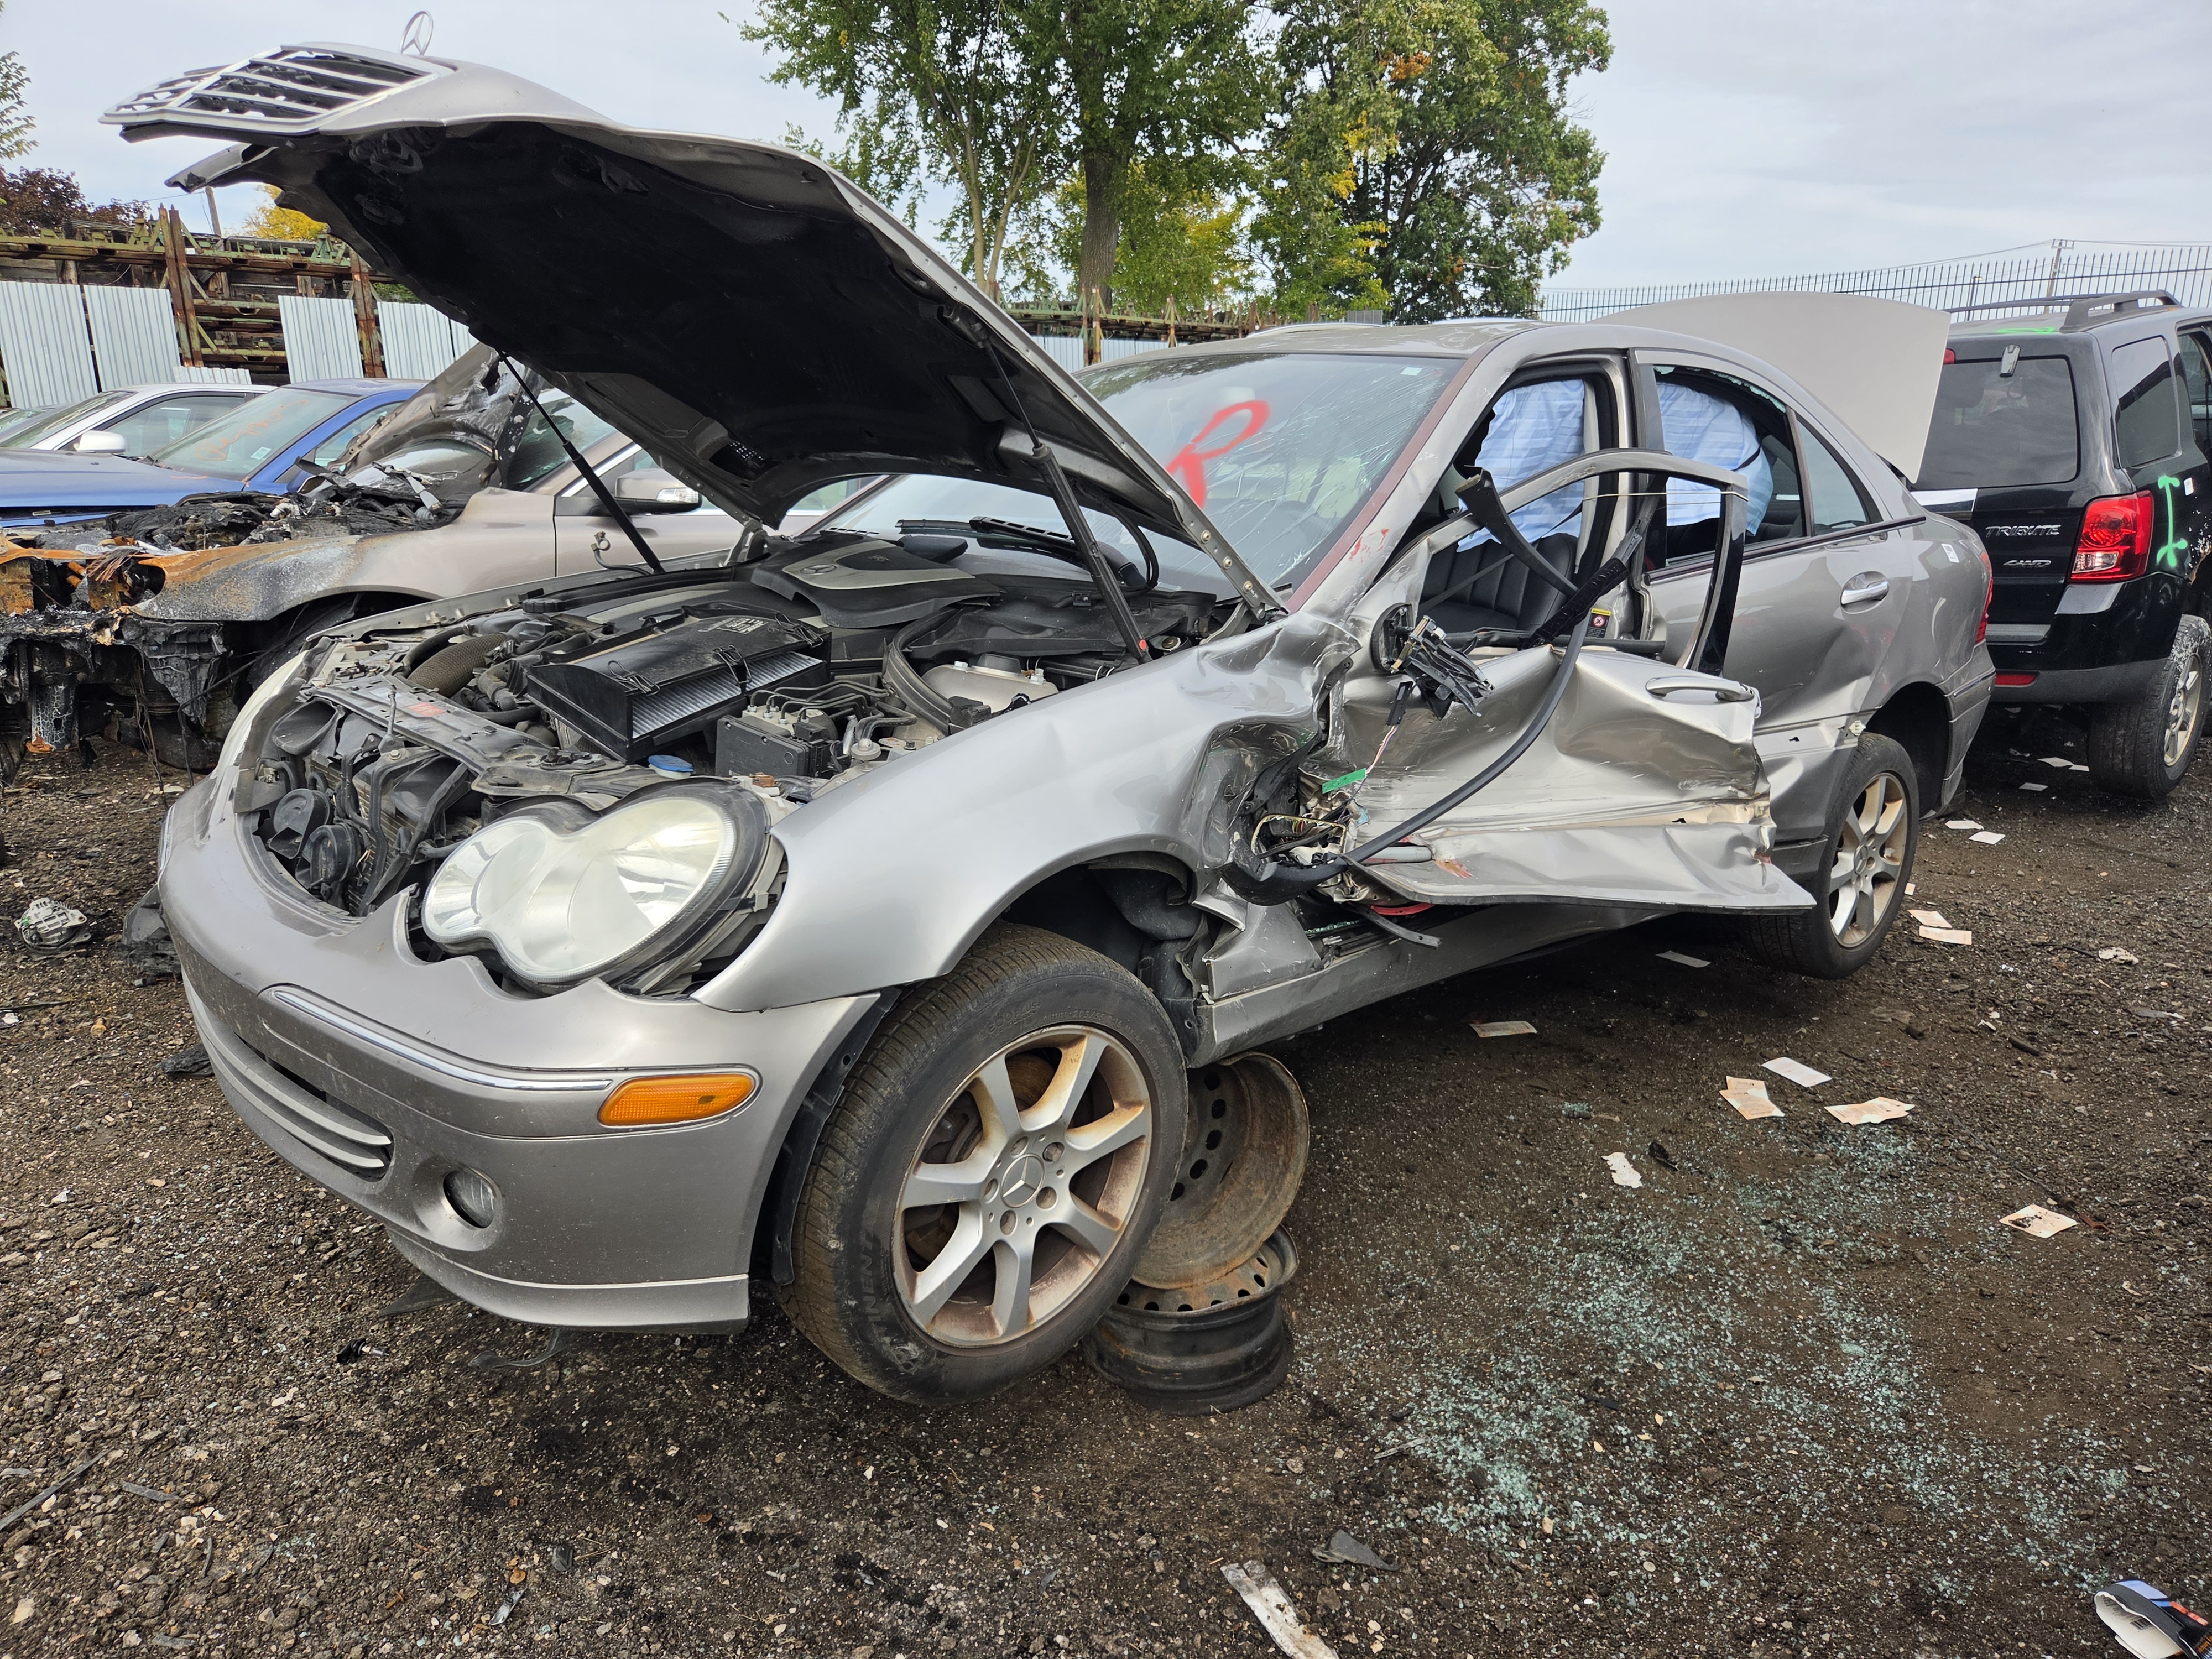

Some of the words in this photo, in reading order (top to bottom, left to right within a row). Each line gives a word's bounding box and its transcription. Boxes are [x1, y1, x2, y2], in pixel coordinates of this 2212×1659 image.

[1166, 400, 1270, 511] R
[1985, 525, 2062, 538] TRIBUTE
[2003, 560, 2052, 568] 4WD
